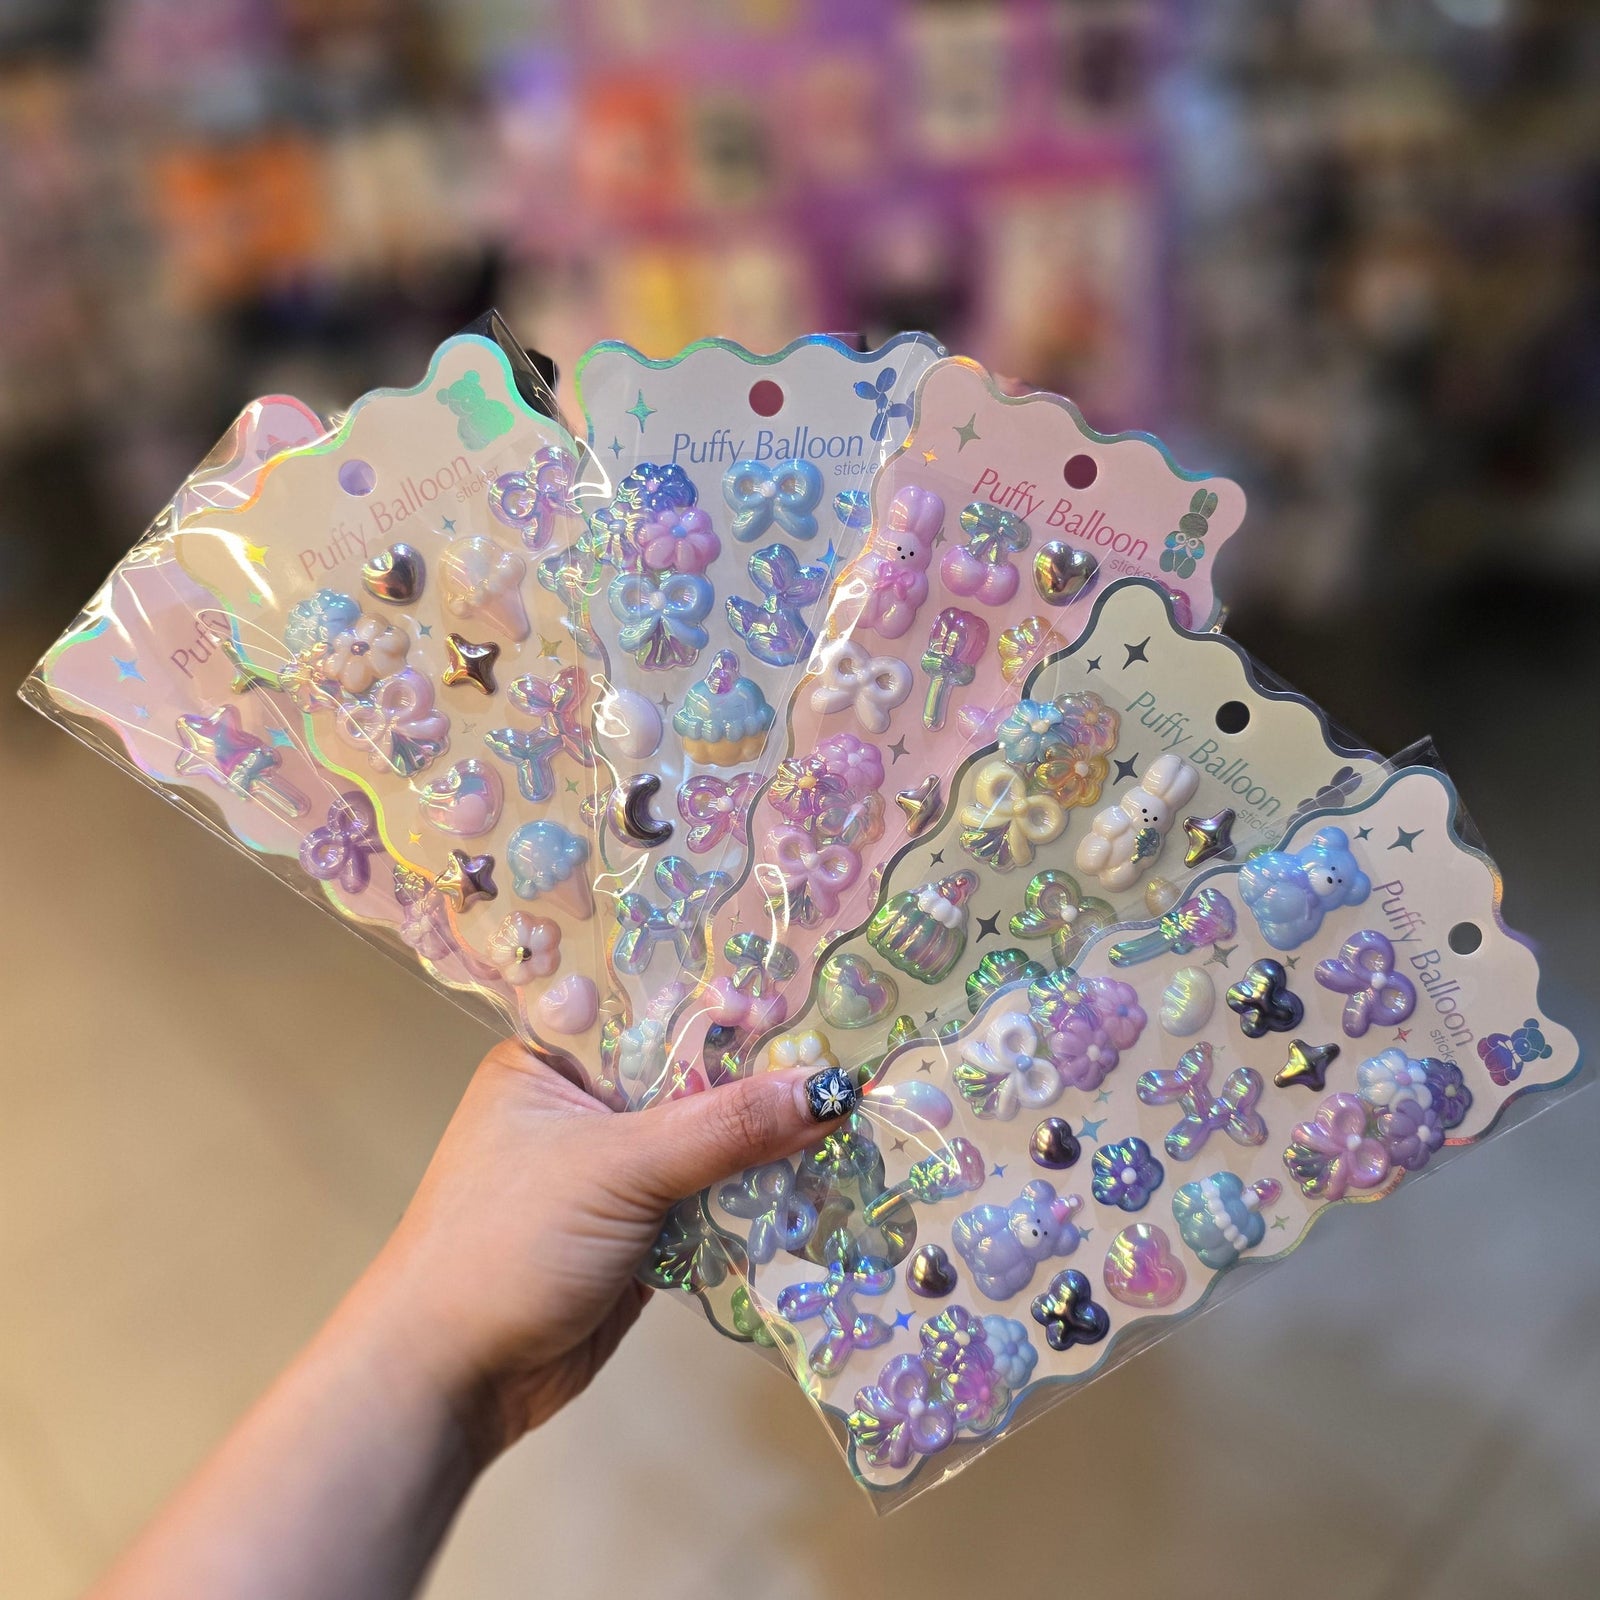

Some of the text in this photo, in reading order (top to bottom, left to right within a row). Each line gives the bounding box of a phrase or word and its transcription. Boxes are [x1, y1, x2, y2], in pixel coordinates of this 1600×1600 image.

[455, 464, 499, 503] sticker
[672, 426, 864, 468] Puffy Balloon
[834, 461, 879, 476] sticke
[299, 456, 473, 582] Puffy Balloon
[972, 467, 1149, 561] Puffy Balloon
[1125, 690, 1281, 817] Puffy Balloon
[1372, 879, 1475, 1047] Puffy Balloon
